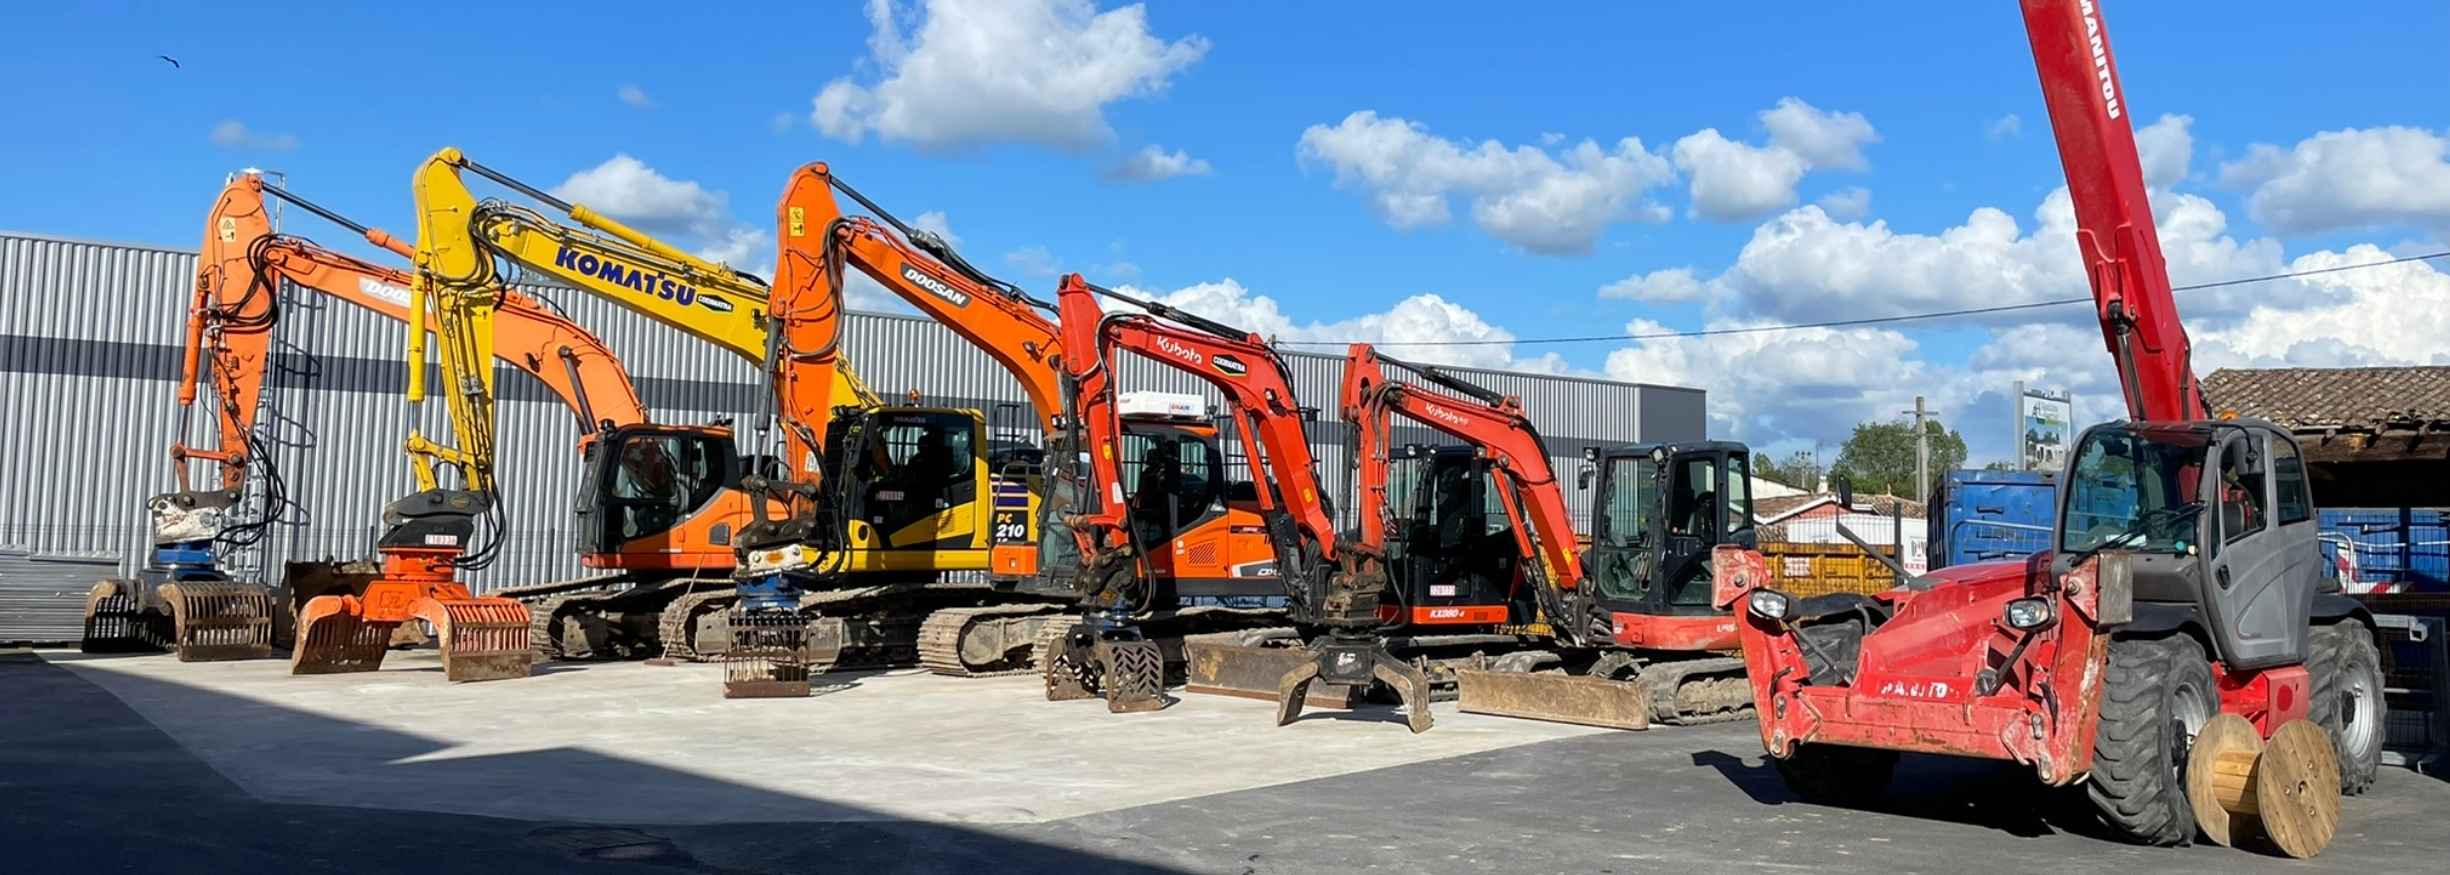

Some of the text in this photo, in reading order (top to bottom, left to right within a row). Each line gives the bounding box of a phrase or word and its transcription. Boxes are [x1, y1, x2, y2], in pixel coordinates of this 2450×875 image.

[2080, 0, 2120, 119] MANITOU
[555, 246, 696, 306] KOMATSU
[904, 268, 967, 305] DOOSAN
[363, 281, 410, 304] DOO
[1156, 335, 1203, 365] Kubota
[1425, 401, 1458, 425] Kubota
[995, 524, 1025, 538] 210
[997, 513, 1013, 524] PC
